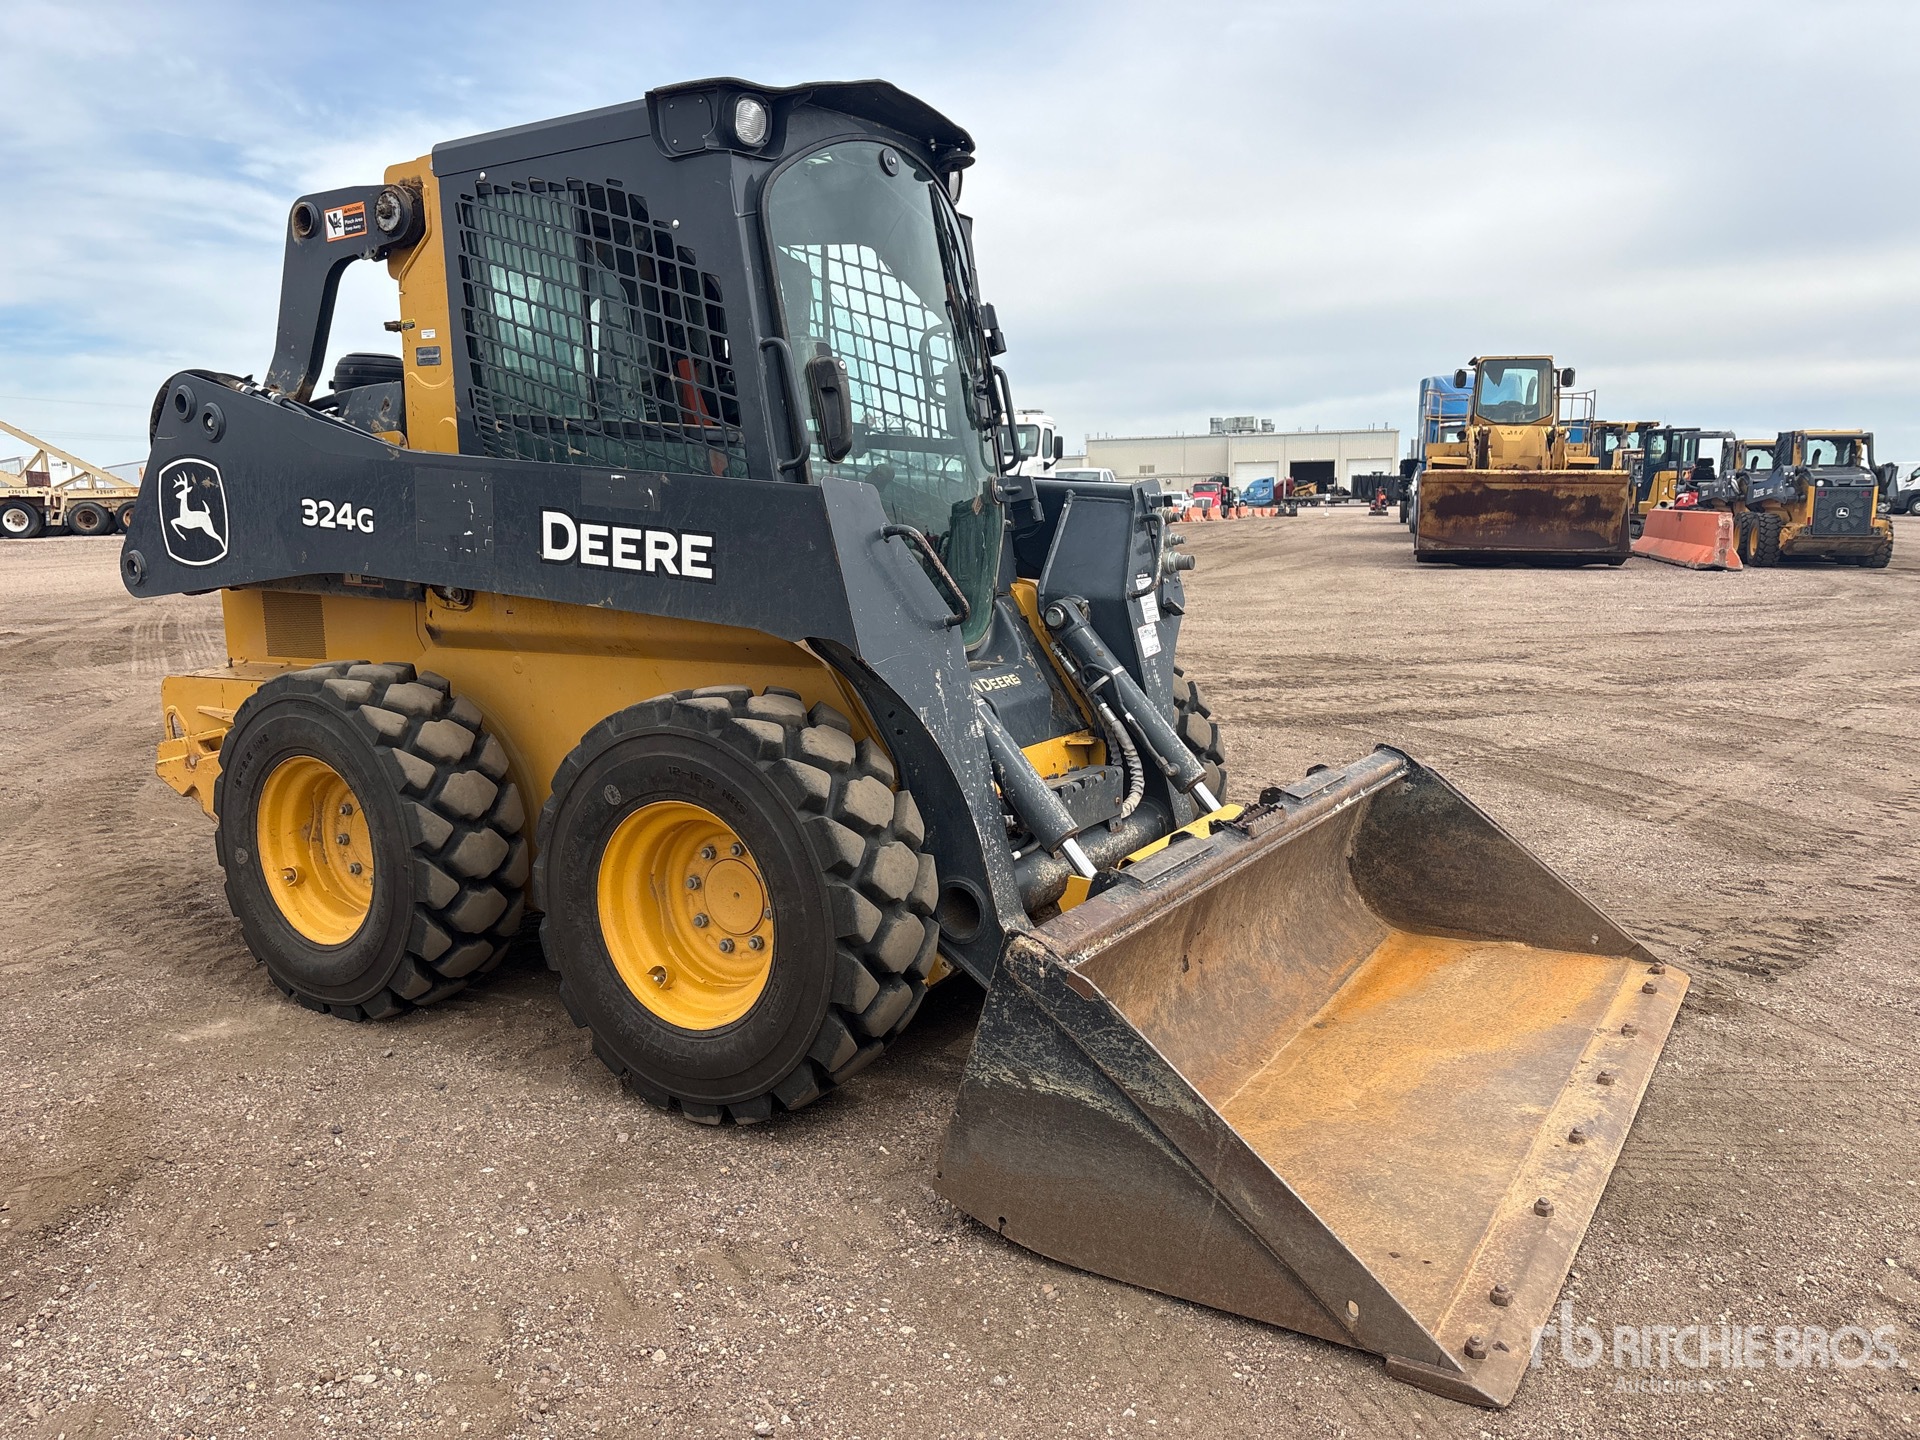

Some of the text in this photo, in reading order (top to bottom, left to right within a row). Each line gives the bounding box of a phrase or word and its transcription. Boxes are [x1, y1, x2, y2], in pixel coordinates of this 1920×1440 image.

[301, 498, 375, 533] 324G
[542, 510, 713, 579] DEERE
[978, 673, 1022, 692] DEERE
[721, 787, 748, 816] NHS
